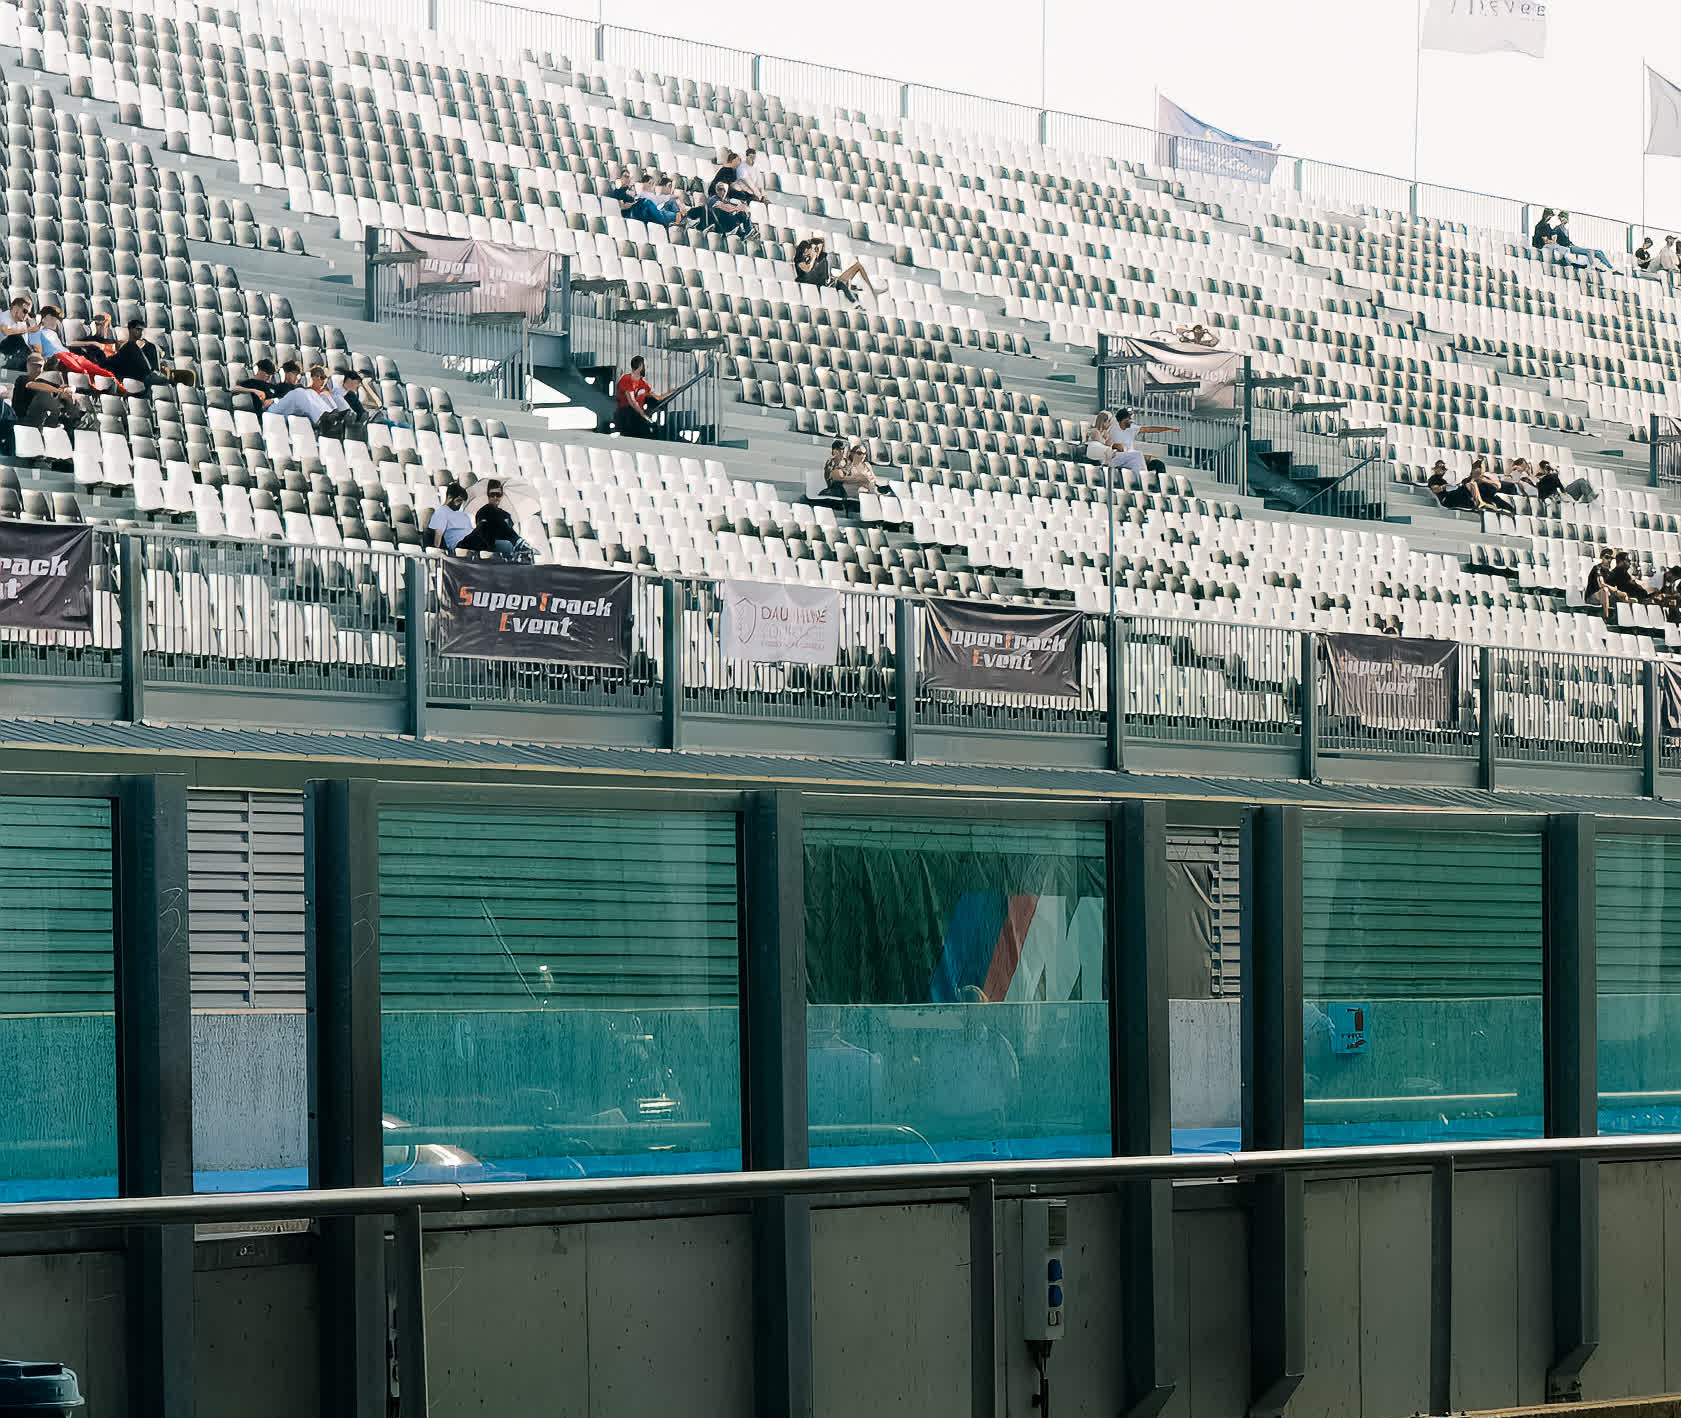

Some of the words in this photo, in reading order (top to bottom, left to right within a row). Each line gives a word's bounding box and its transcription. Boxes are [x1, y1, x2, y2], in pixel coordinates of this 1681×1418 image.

[459, 586, 613, 617] SuperTrack
[499, 612, 573, 636] Event
[972, 648, 1033, 671] Event
